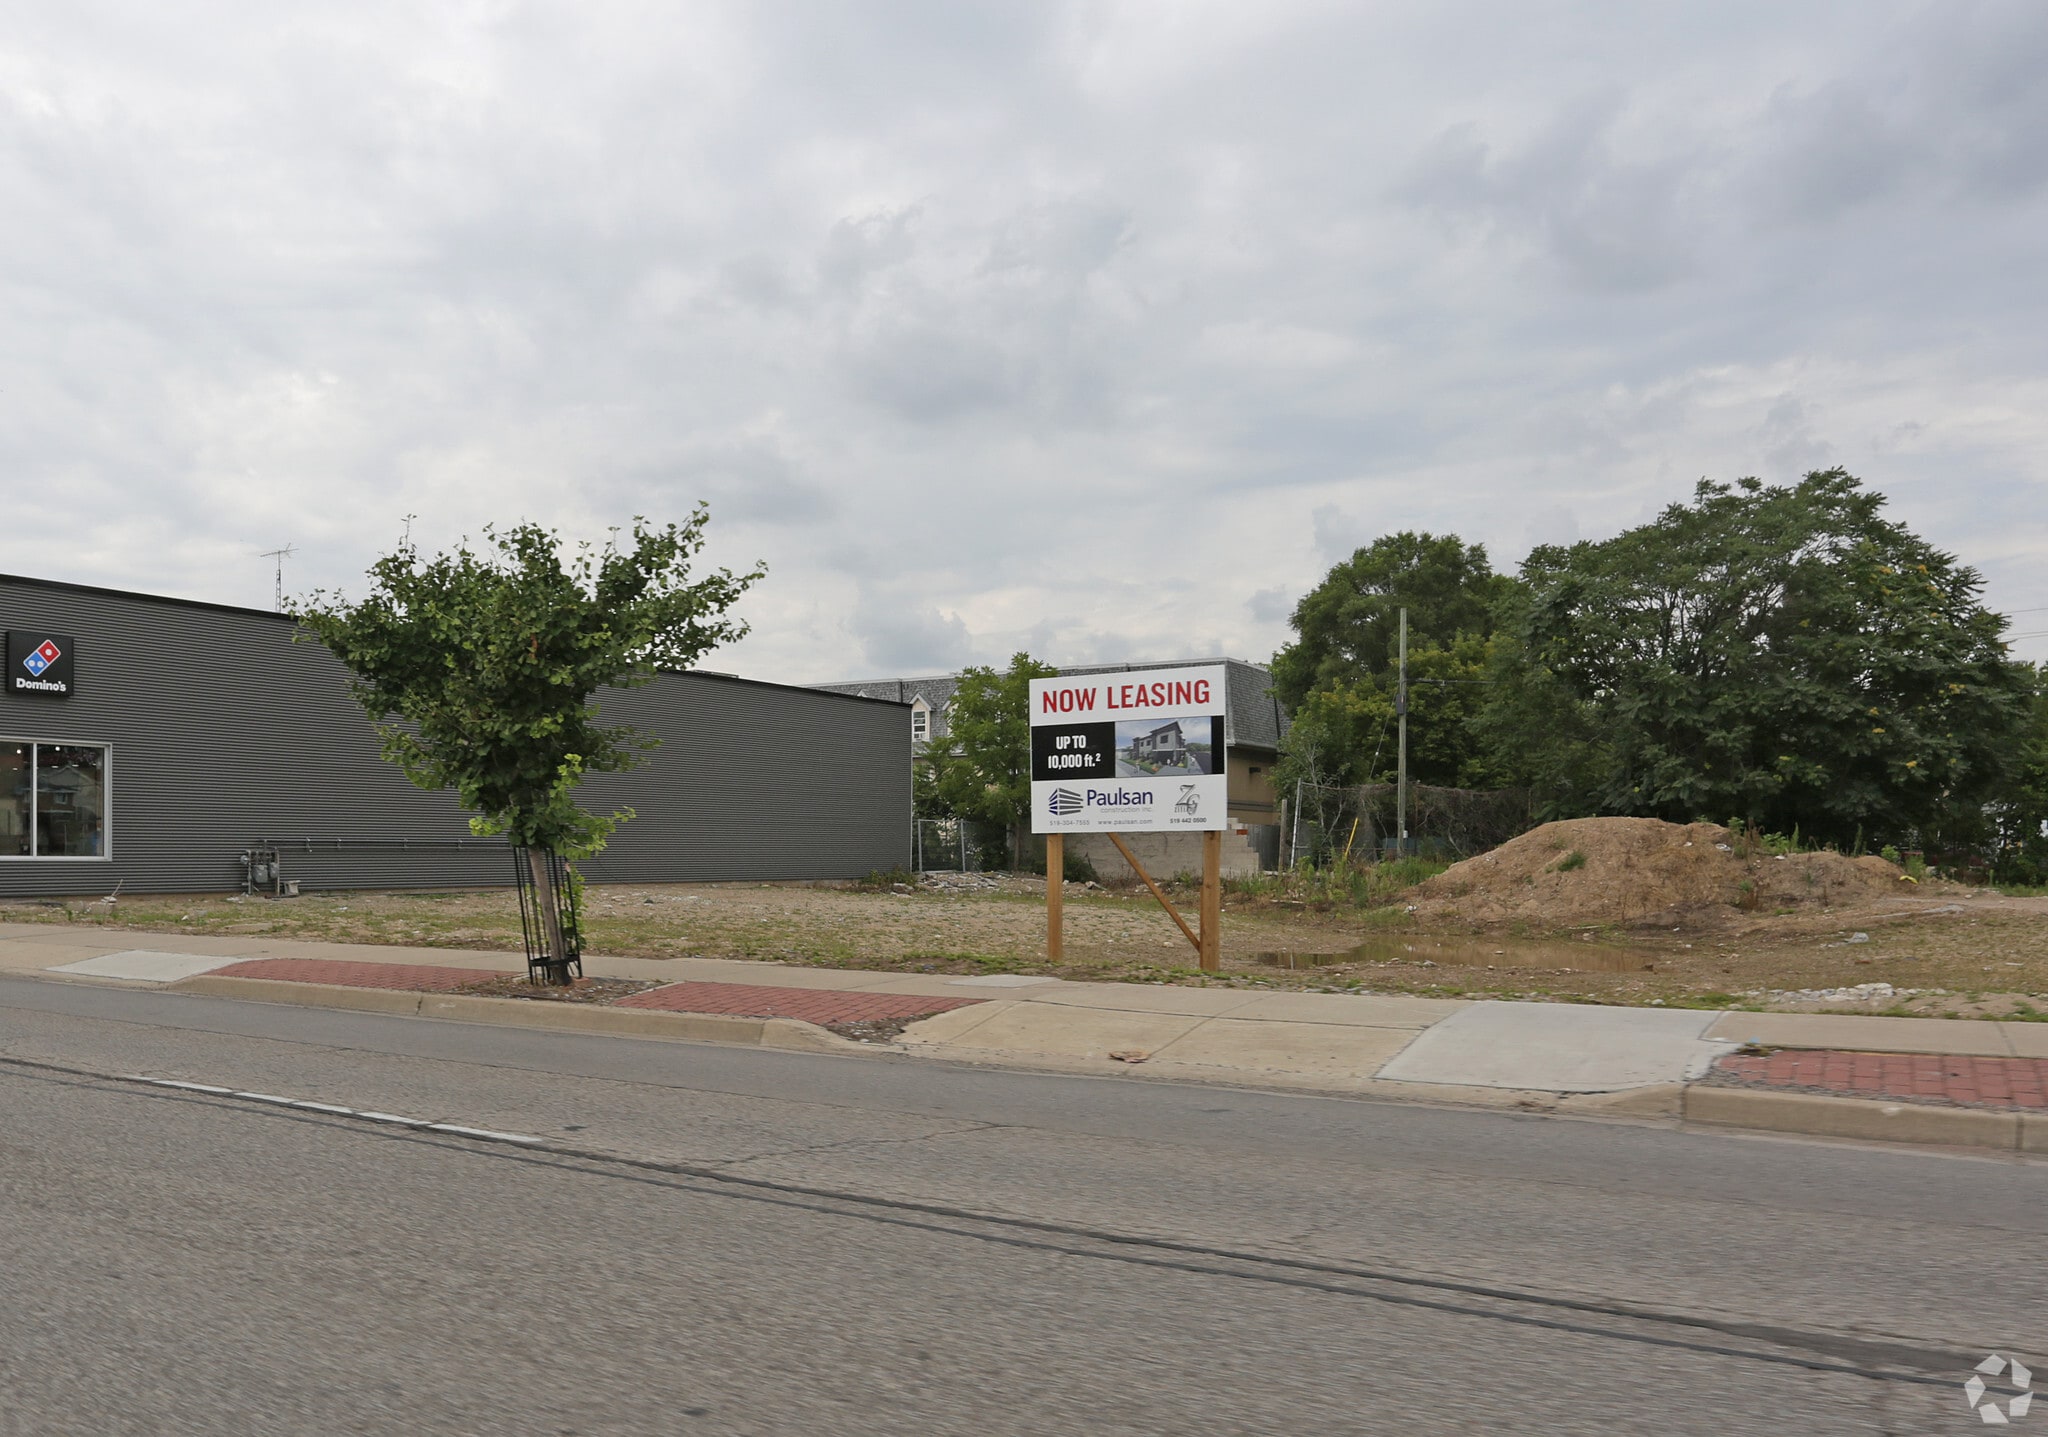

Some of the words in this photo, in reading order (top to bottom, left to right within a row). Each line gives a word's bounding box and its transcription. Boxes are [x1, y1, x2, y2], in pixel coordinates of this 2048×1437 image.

[16, 677, 67, 692] Domino's
[1043, 688, 1096, 713] NOW
[1107, 679, 1210, 709] LEASING
[1056, 736, 1071, 749] UP
[1072, 735, 1086, 749] TO
[1048, 754, 1082, 769] 10,000
[1087, 787, 1153, 806] Paulsan
